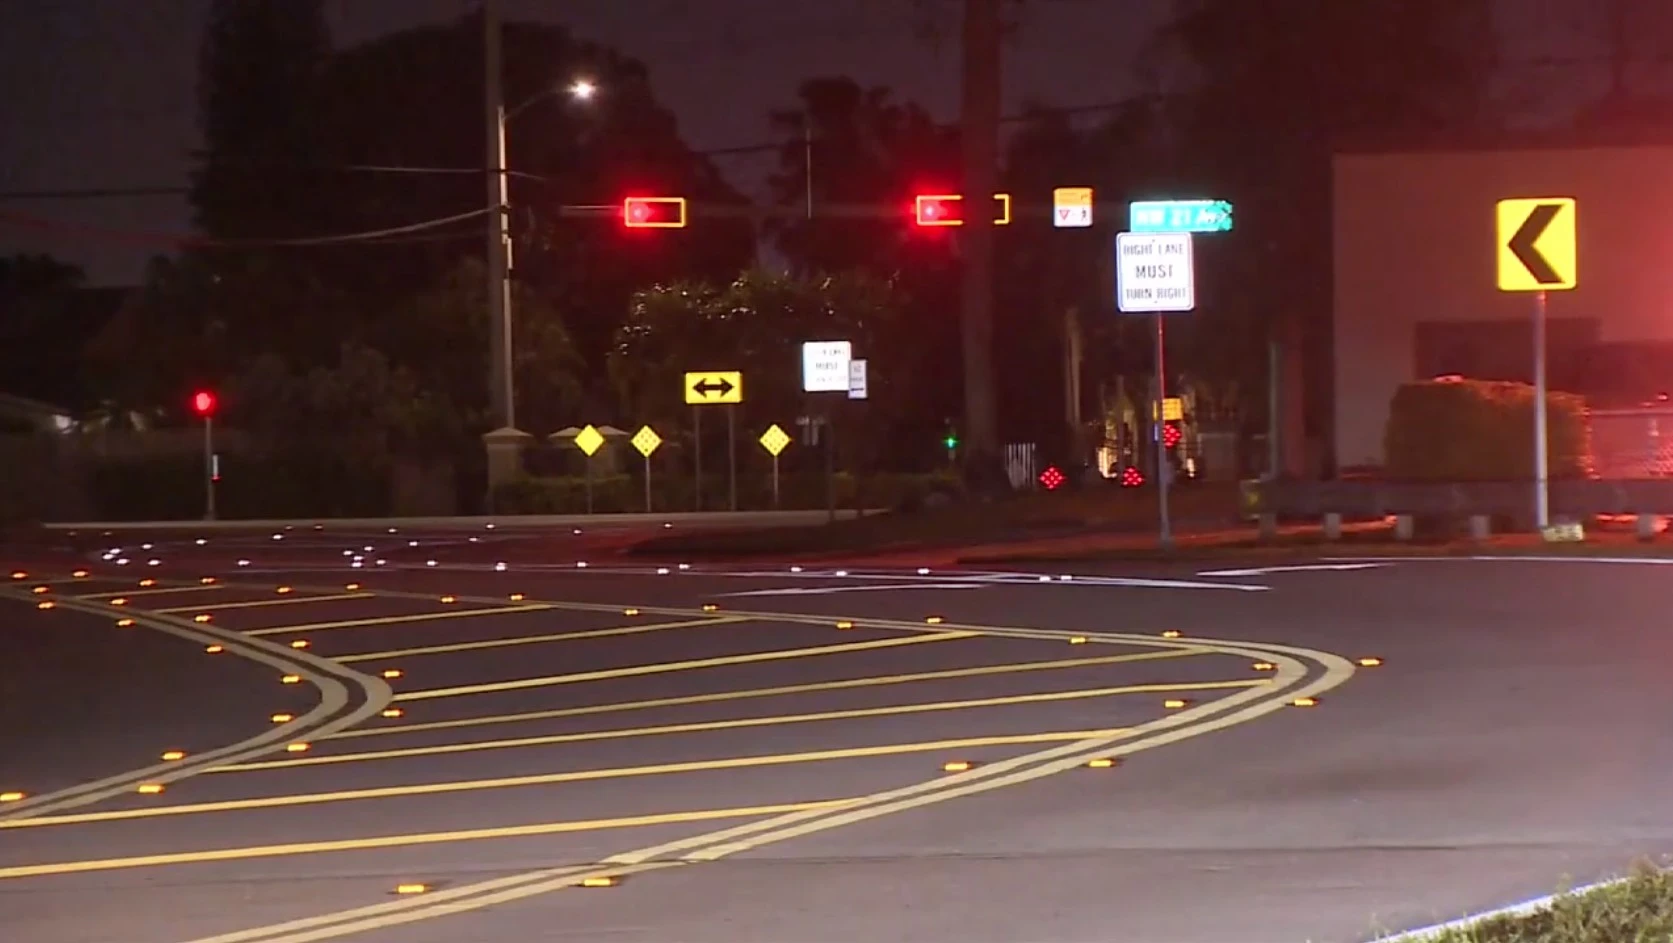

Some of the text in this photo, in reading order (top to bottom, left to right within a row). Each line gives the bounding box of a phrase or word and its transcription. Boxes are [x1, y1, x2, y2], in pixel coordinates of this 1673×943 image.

[1123, 243, 1185, 256] RIGHT LANE
[1135, 264, 1173, 279] MUST
[1126, 287, 1186, 300] TURN RIGHT
